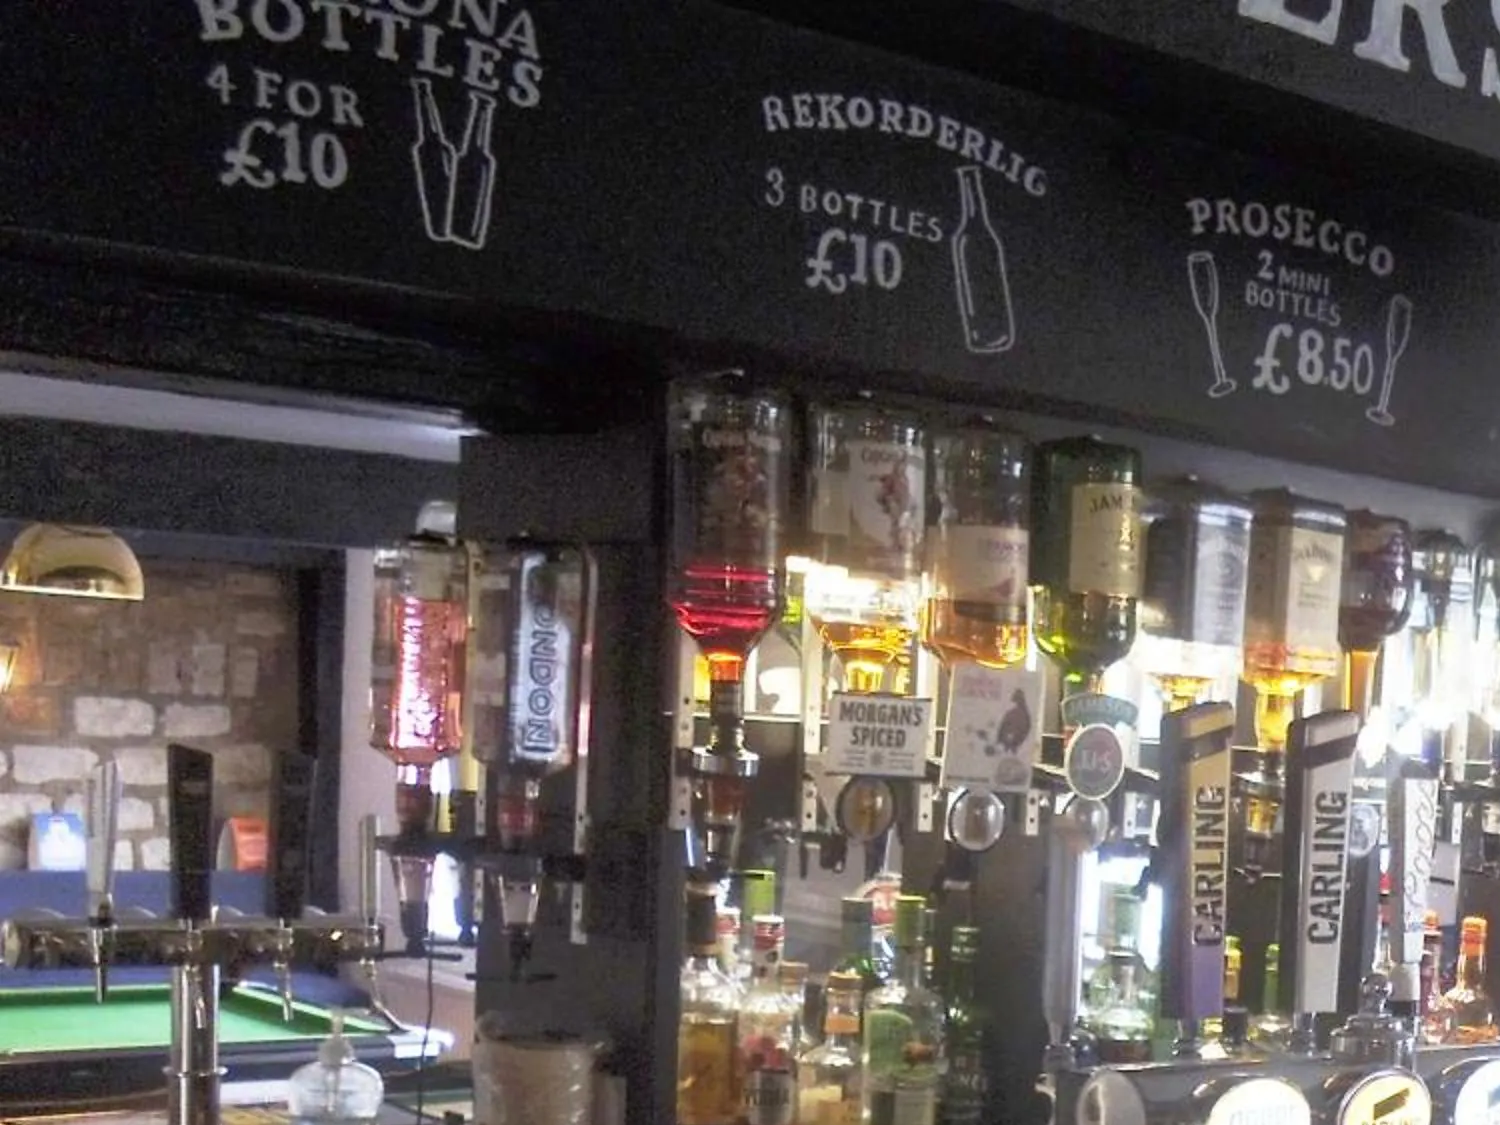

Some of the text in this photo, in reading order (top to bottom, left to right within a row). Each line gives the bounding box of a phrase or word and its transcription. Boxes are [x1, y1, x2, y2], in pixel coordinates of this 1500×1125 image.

[193, 0, 544, 107] BOTTLES
[206, 63, 363, 127] 4 FOR
[220, 119, 348, 189] £10
[761, 93, 1047, 197] REKORDERLIG
[764, 167, 943, 243] 3 BOTTLES
[1185, 197, 1395, 276] PROSECCO
[805, 227, 903, 294] £10
[1257, 249, 1330, 297] 2 MINI
[1245, 279, 1342, 327] BOTTLES
[1252, 323, 1375, 394] £8.50
[525, 604, 560, 748] ONDON
[838, 701, 923, 728] MORGAN'S
[850, 725, 906, 749] SPICED
[1193, 783, 1225, 947] CARLING
[1307, 791, 1347, 945] CARLING
